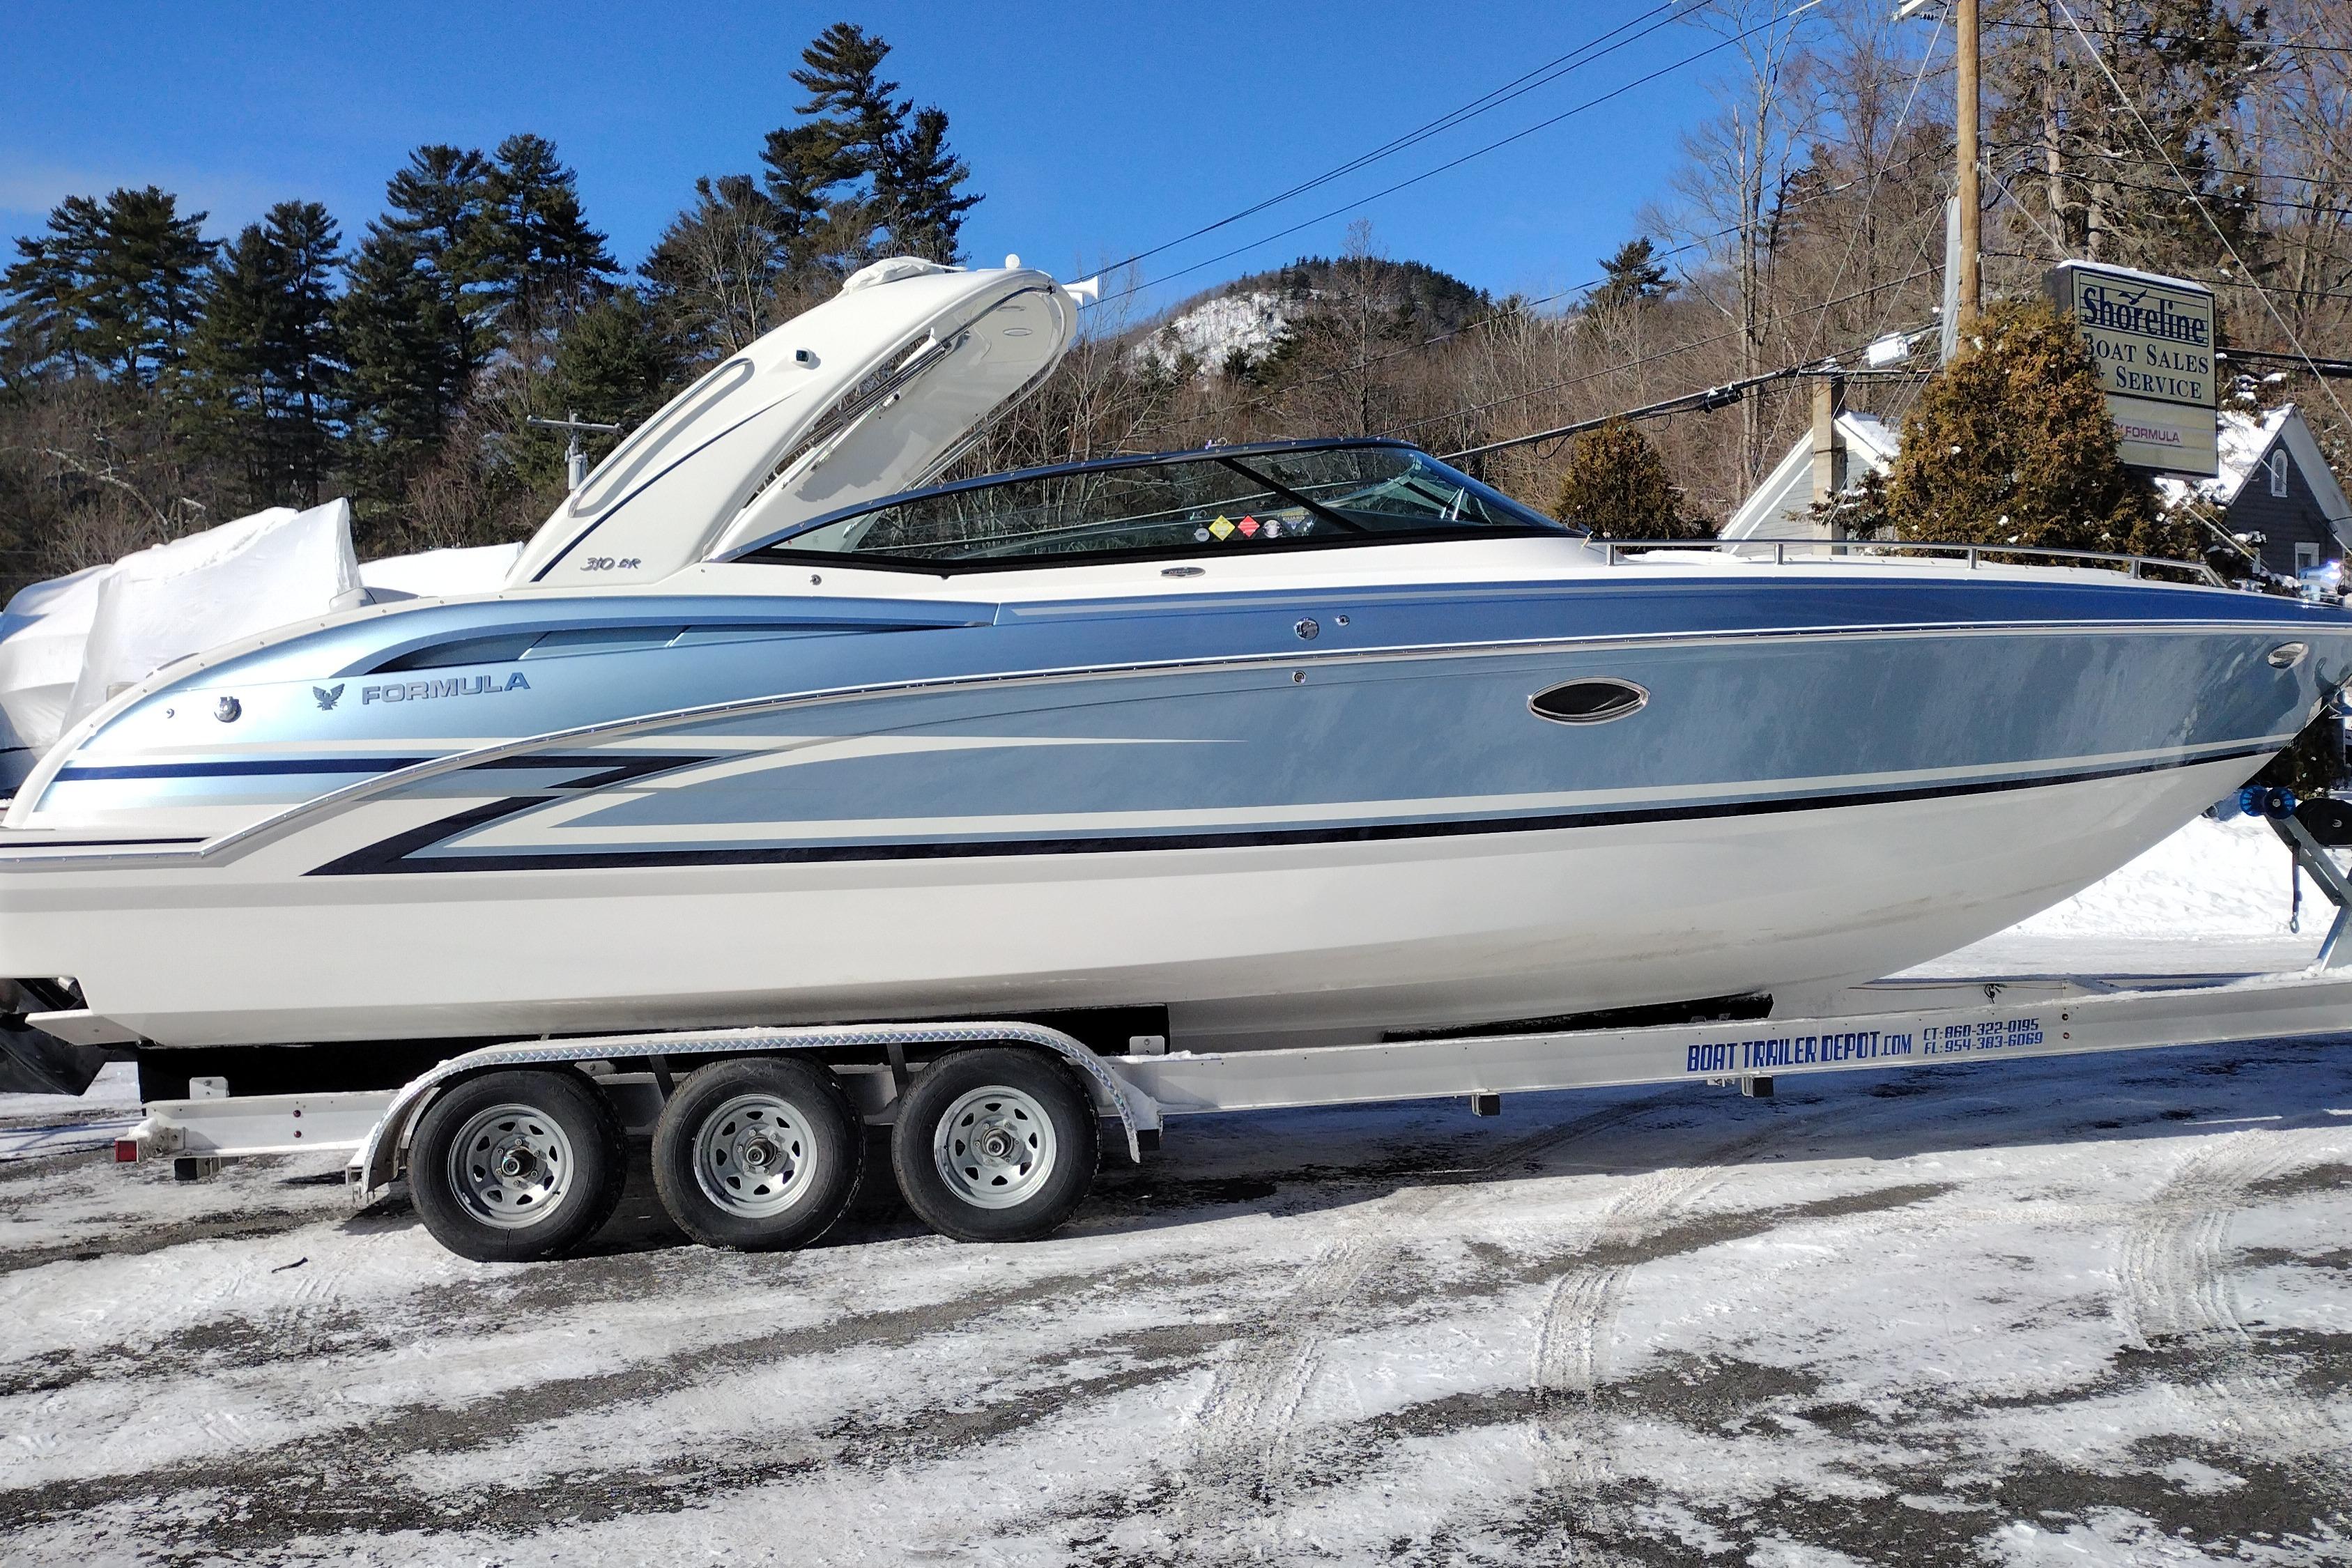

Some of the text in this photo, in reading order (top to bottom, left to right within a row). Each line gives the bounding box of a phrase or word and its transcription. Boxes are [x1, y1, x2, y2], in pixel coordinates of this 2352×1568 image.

[2083, 286, 2205, 344] Shoreline
[2082, 331, 2208, 374] BOAT SALES
[2116, 366, 2202, 399] SERVICE
[2125, 425, 2181, 443] FORMULA
[580, 557, 615, 571] 310
[362, 672, 531, 705] FORMULA
[1687, 1043, 1738, 1072] BOAT
[1742, 1036, 1817, 1068] TRAILER
